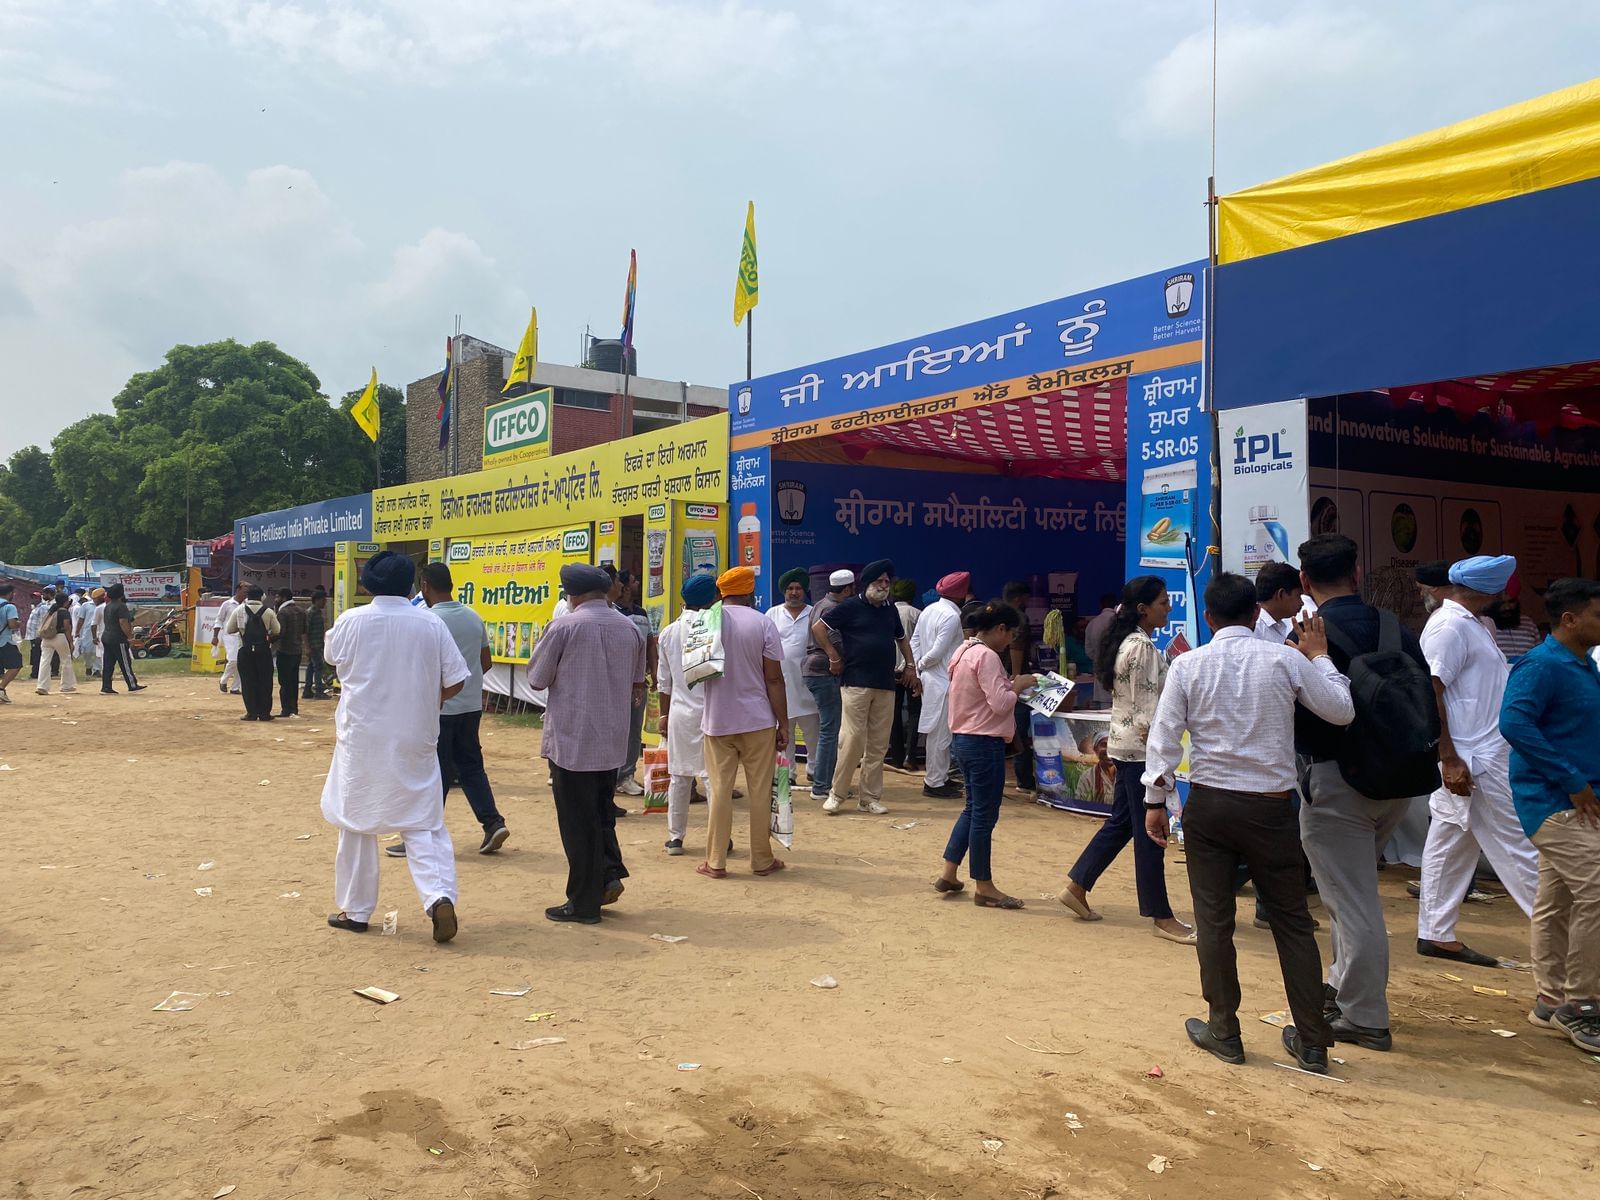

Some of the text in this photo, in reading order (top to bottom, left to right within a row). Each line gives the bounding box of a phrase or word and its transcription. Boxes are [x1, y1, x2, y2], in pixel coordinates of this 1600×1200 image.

[1167, 274, 1192, 286] SHRIRAM
[1152, 332, 1174, 340] Better
[1153, 324, 1174, 334] Better
[779, 298, 1108, 408] ਜੀ ਆਇਆਂ ਨੂੰ
[1026, 360, 1134, 392] ਕੈਮੀਕਲਸ
[493, 407, 539, 442] IFFCO
[1148, 407, 1191, 434] ਸੁਪਰ
[1141, 436, 1198, 460] 5-SR-05
[1337, 414, 1410, 444] Innovative
[1412, 425, 1469, 452] Solutions
[1470, 434, 1488, 454] for
[1490, 438, 1552, 463] Sustainable
[646, 452, 655, 468] ਦਾ
[1234, 461, 1292, 475] Biologicals
[248, 528, 260, 544] Yara
[260, 522, 286, 542] Fertilisers
[287, 519, 302, 538] India
[304, 516, 328, 536] Private
[330, 508, 362, 532] Limited
[1034, 501, 1088, 532] ਪਲਾਂਟ
[452, 546, 468, 556] IFFCO
[566, 534, 586, 548] IFFCO
[458, 582, 474, 604] ਜੀ
[482, 581, 550, 606] ਆਇਆਂ
